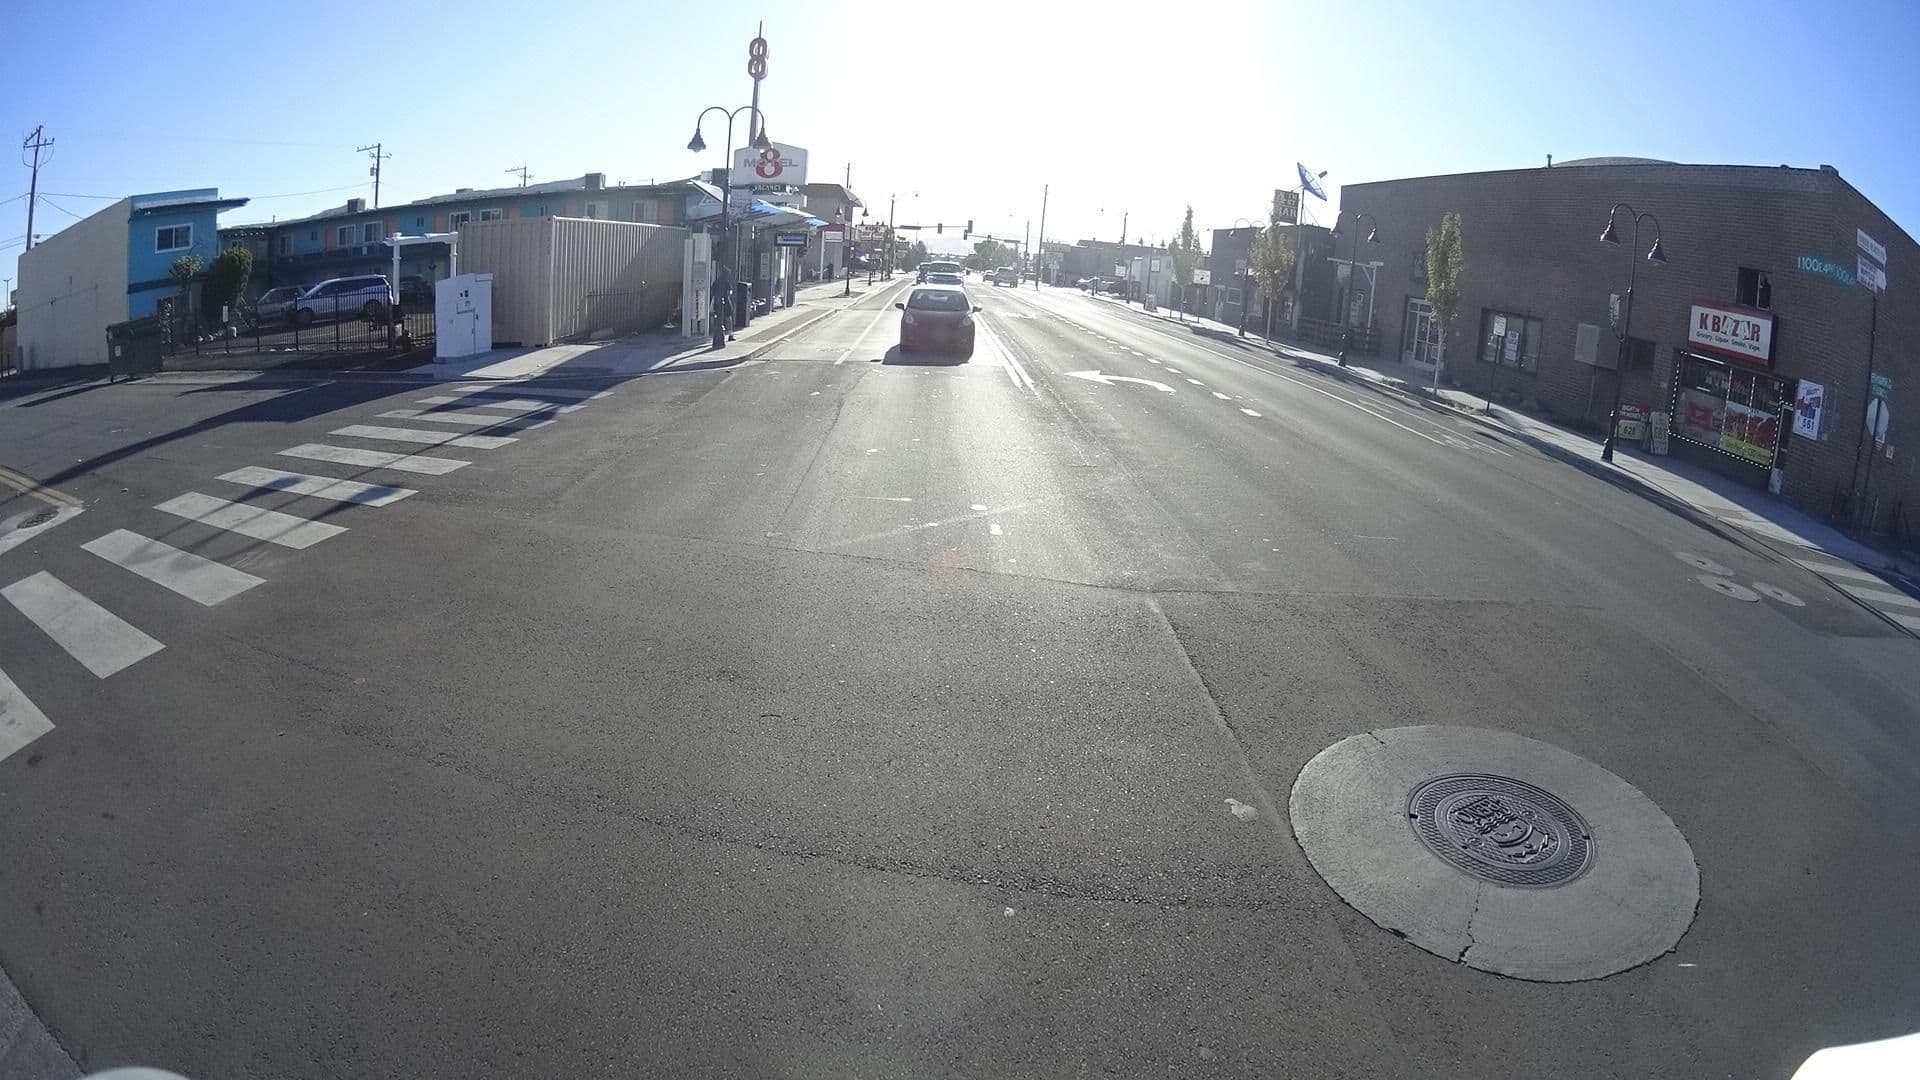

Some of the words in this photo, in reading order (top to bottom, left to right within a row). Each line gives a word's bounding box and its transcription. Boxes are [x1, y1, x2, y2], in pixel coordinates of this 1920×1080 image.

[755, 148, 784, 178] 8
[1797, 256, 1819, 271] 1100
[1699, 312, 1709, 330] K
[1711, 314, 1760, 342] BAZAR
